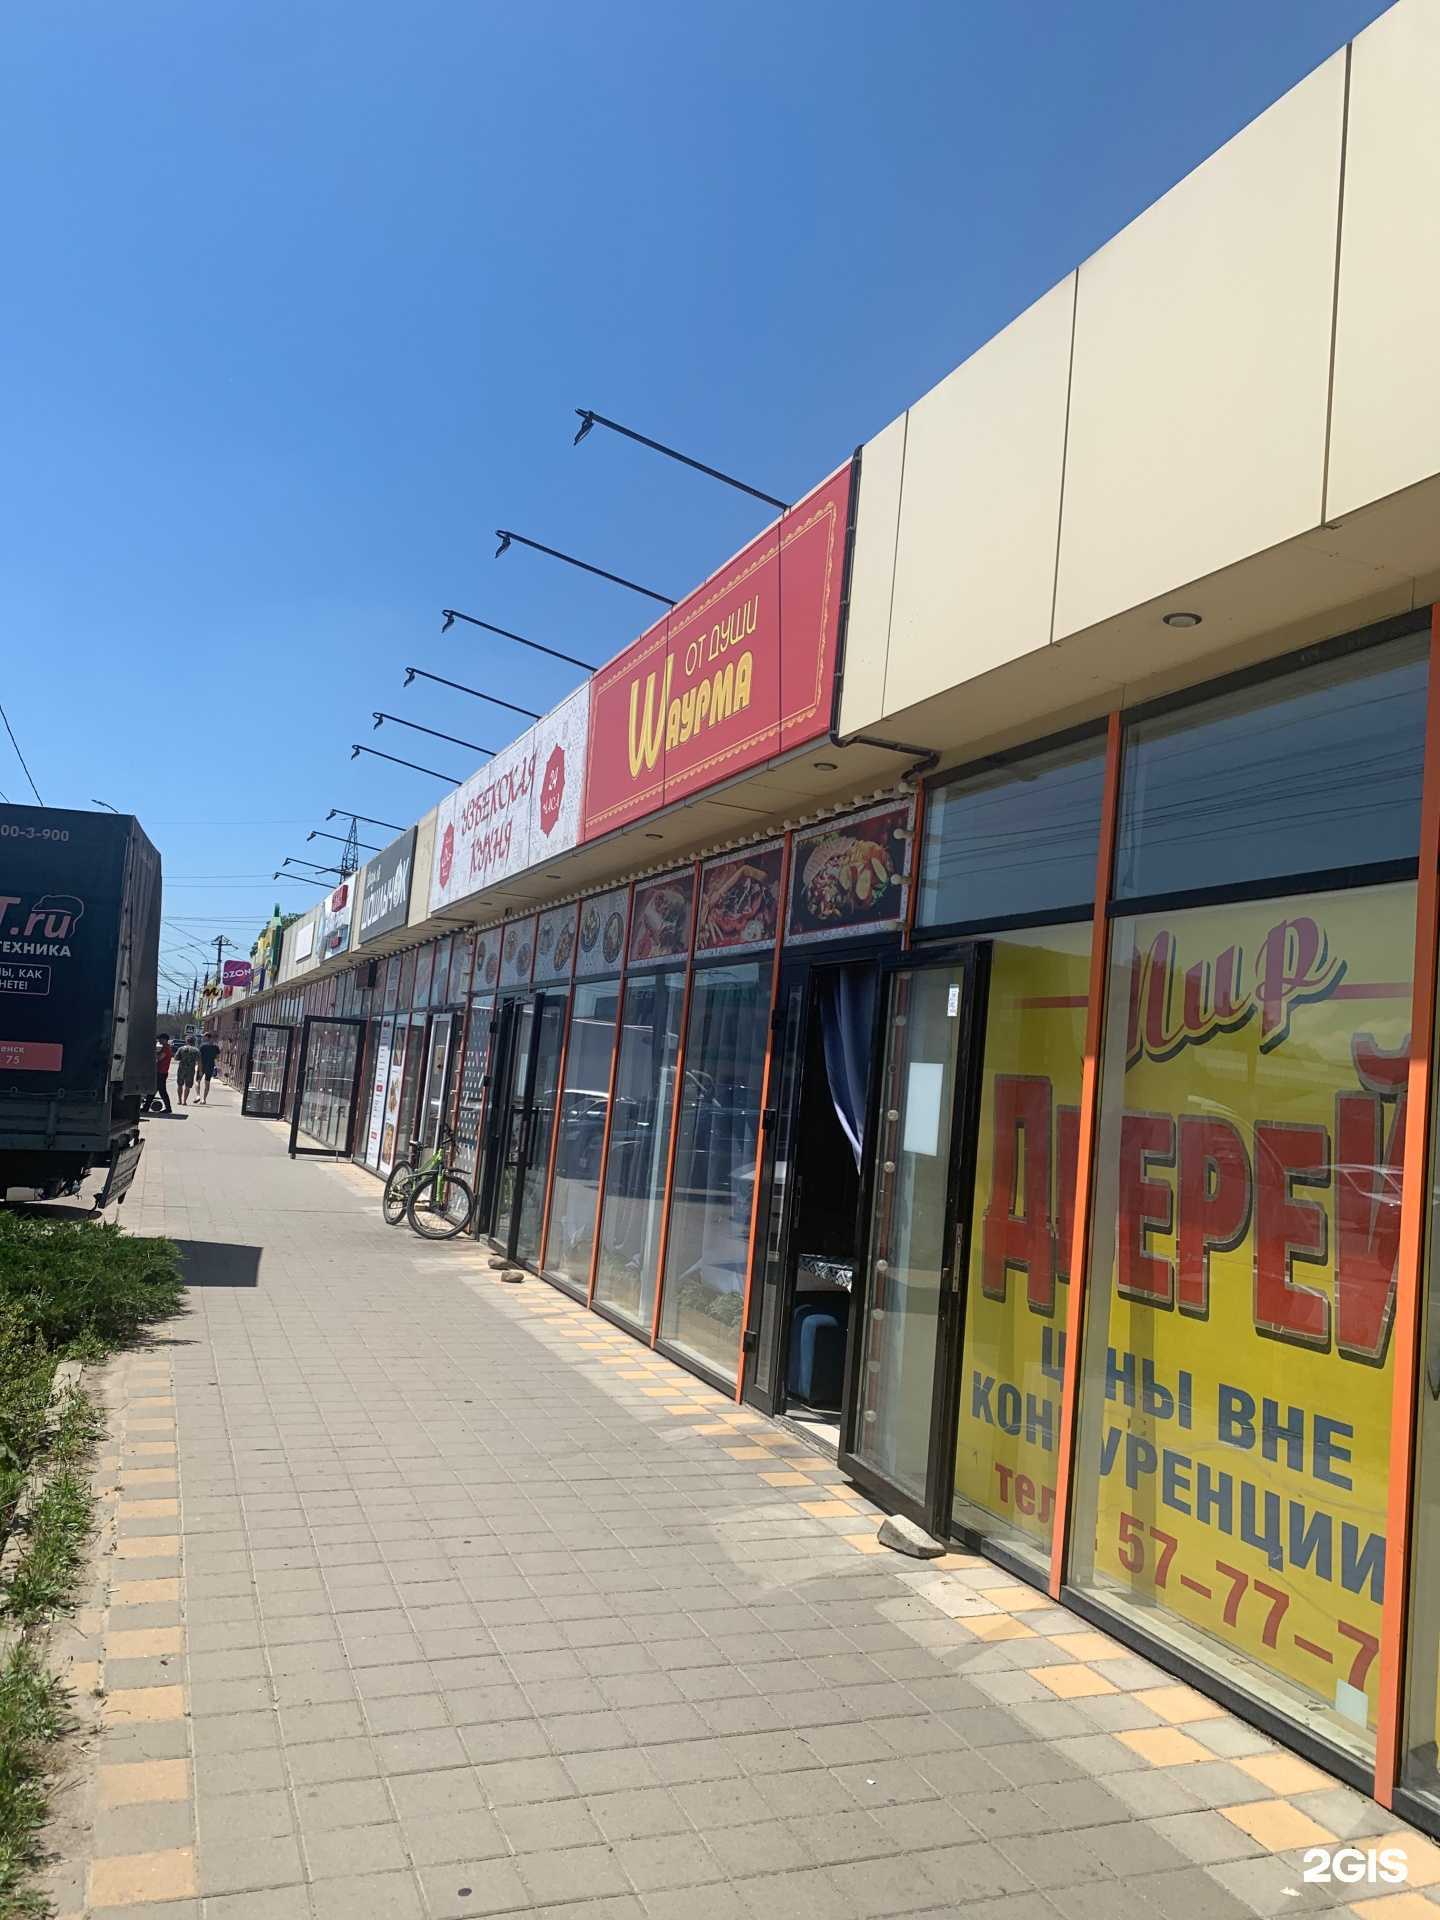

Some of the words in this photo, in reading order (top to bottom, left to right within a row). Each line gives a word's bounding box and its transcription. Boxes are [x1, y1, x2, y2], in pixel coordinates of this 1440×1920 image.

[0, 940, 72, 957] ЕХНИКА
[19, 969, 43, 980] КАК
[982, 1033, 1409, 1368] ДЕРЕЙ
[971, 1370, 1386, 1606] КОНУРЕНЦИИ
[1041, 1326, 1193, 1430] ЦНЫ
[1218, 1383, 1354, 1491] ВНЕ
